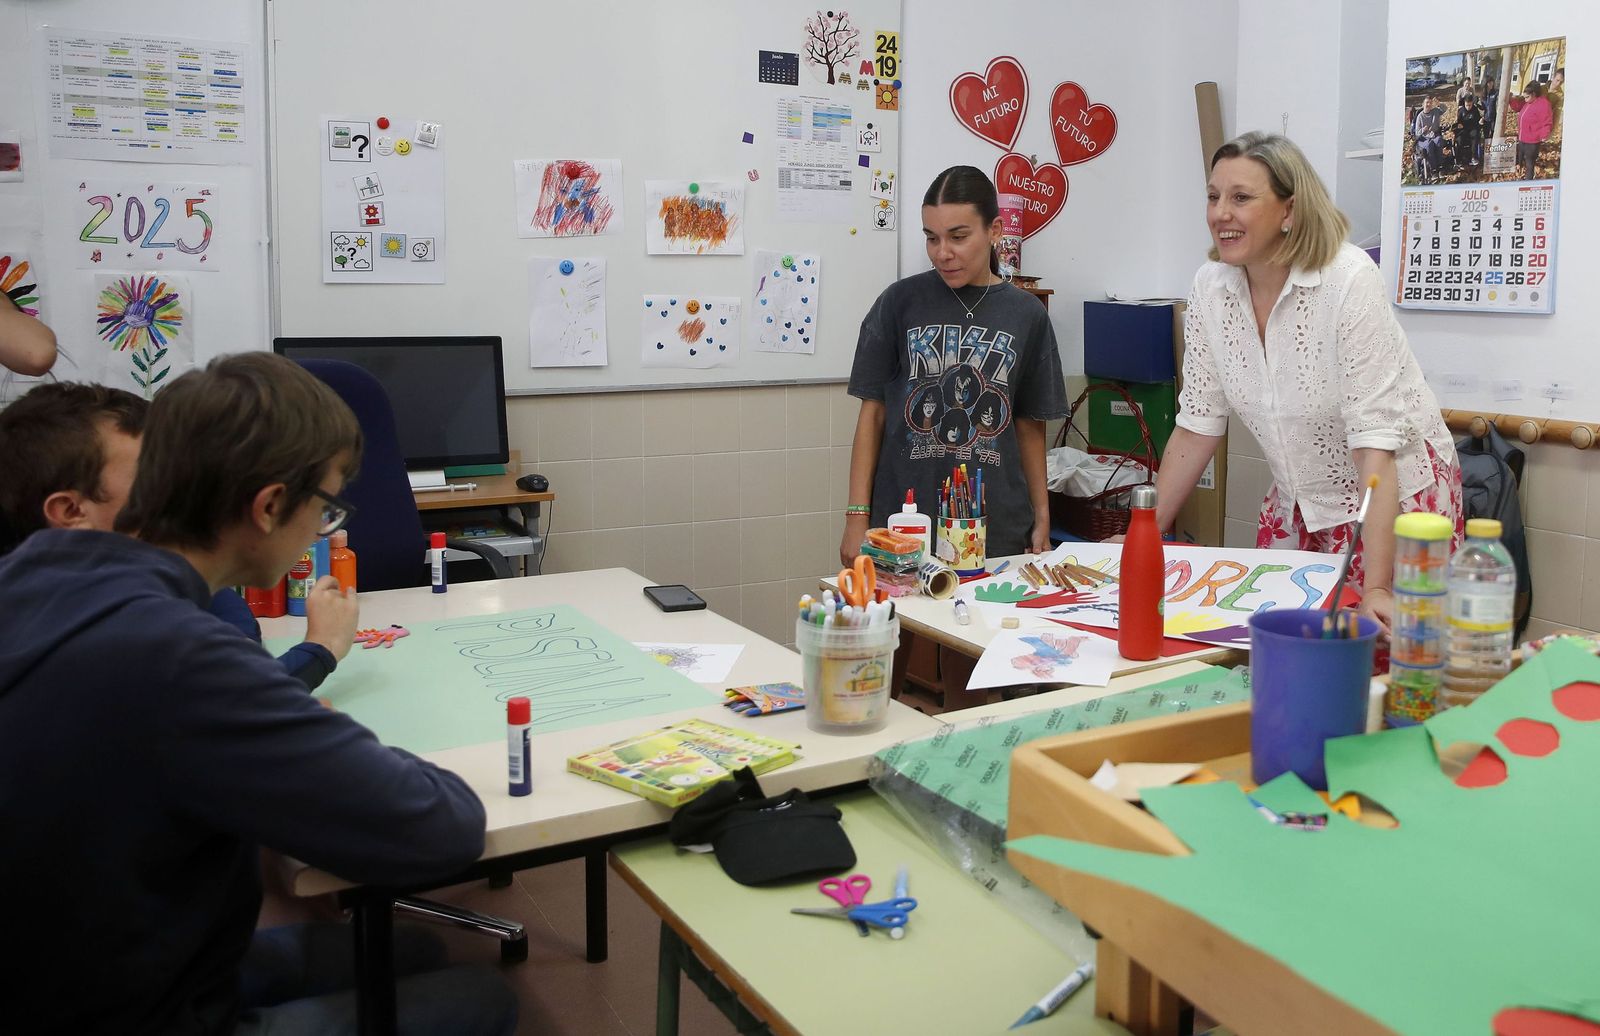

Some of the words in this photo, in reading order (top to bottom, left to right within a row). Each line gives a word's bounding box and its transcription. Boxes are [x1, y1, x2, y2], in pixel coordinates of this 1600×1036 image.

[876, 34, 898, 54] 24
[876, 56, 896, 78] 19
[982, 85, 1000, 102] MI
[974, 98, 1020, 128] FUTURO
[1078, 110, 1093, 126] TU
[1055, 116, 1097, 152] FUTURO
[1008, 174, 1055, 197] NUESTRO
[1461, 190, 1490, 200] JULIO
[1023, 198, 1048, 215] TURO
[1462, 201, 1488, 213] 2025
[80, 195, 213, 254] 2025
[1435, 220, 1438, 232] 1
[1452, 220, 1460, 231] 2
[1472, 219, 1480, 231] 3
[1493, 219, 1502, 231] 4
[1514, 218, 1523, 231] 5
[1535, 218, 1544, 231] 6
[1413, 237, 1421, 249] 7
[1432, 237, 1440, 249] 8
[1451, 237, 1459, 249] 9
[1470, 237, 1482, 249] 10
[1492, 236, 1500, 249] 11
[1511, 236, 1524, 249] 12
[1533, 236, 1546, 249] 13
[1411, 254, 1421, 266] 14
[1429, 254, 1441, 266] 15
[1449, 254, 1461, 266] 16
[1469, 254, 1481, 266] 17
[1489, 254, 1502, 267] 18
[1510, 254, 1523, 267] 19
[1528, 254, 1547, 267] 20
[1408, 271, 1421, 283] 21
[1426, 271, 1442, 283] 22
[1445, 271, 1462, 283] 23
[1465, 272, 1482, 284] 24
[1485, 272, 1503, 284] 25
[1506, 272, 1524, 284] 26
[1527, 272, 1546, 285] 27
[1405, 288, 1421, 299] 28
[1424, 288, 1441, 300] 29
[1444, 288, 1461, 300] 30
[1464, 289, 1480, 301] 31
[907, 325, 1017, 386] KISS
